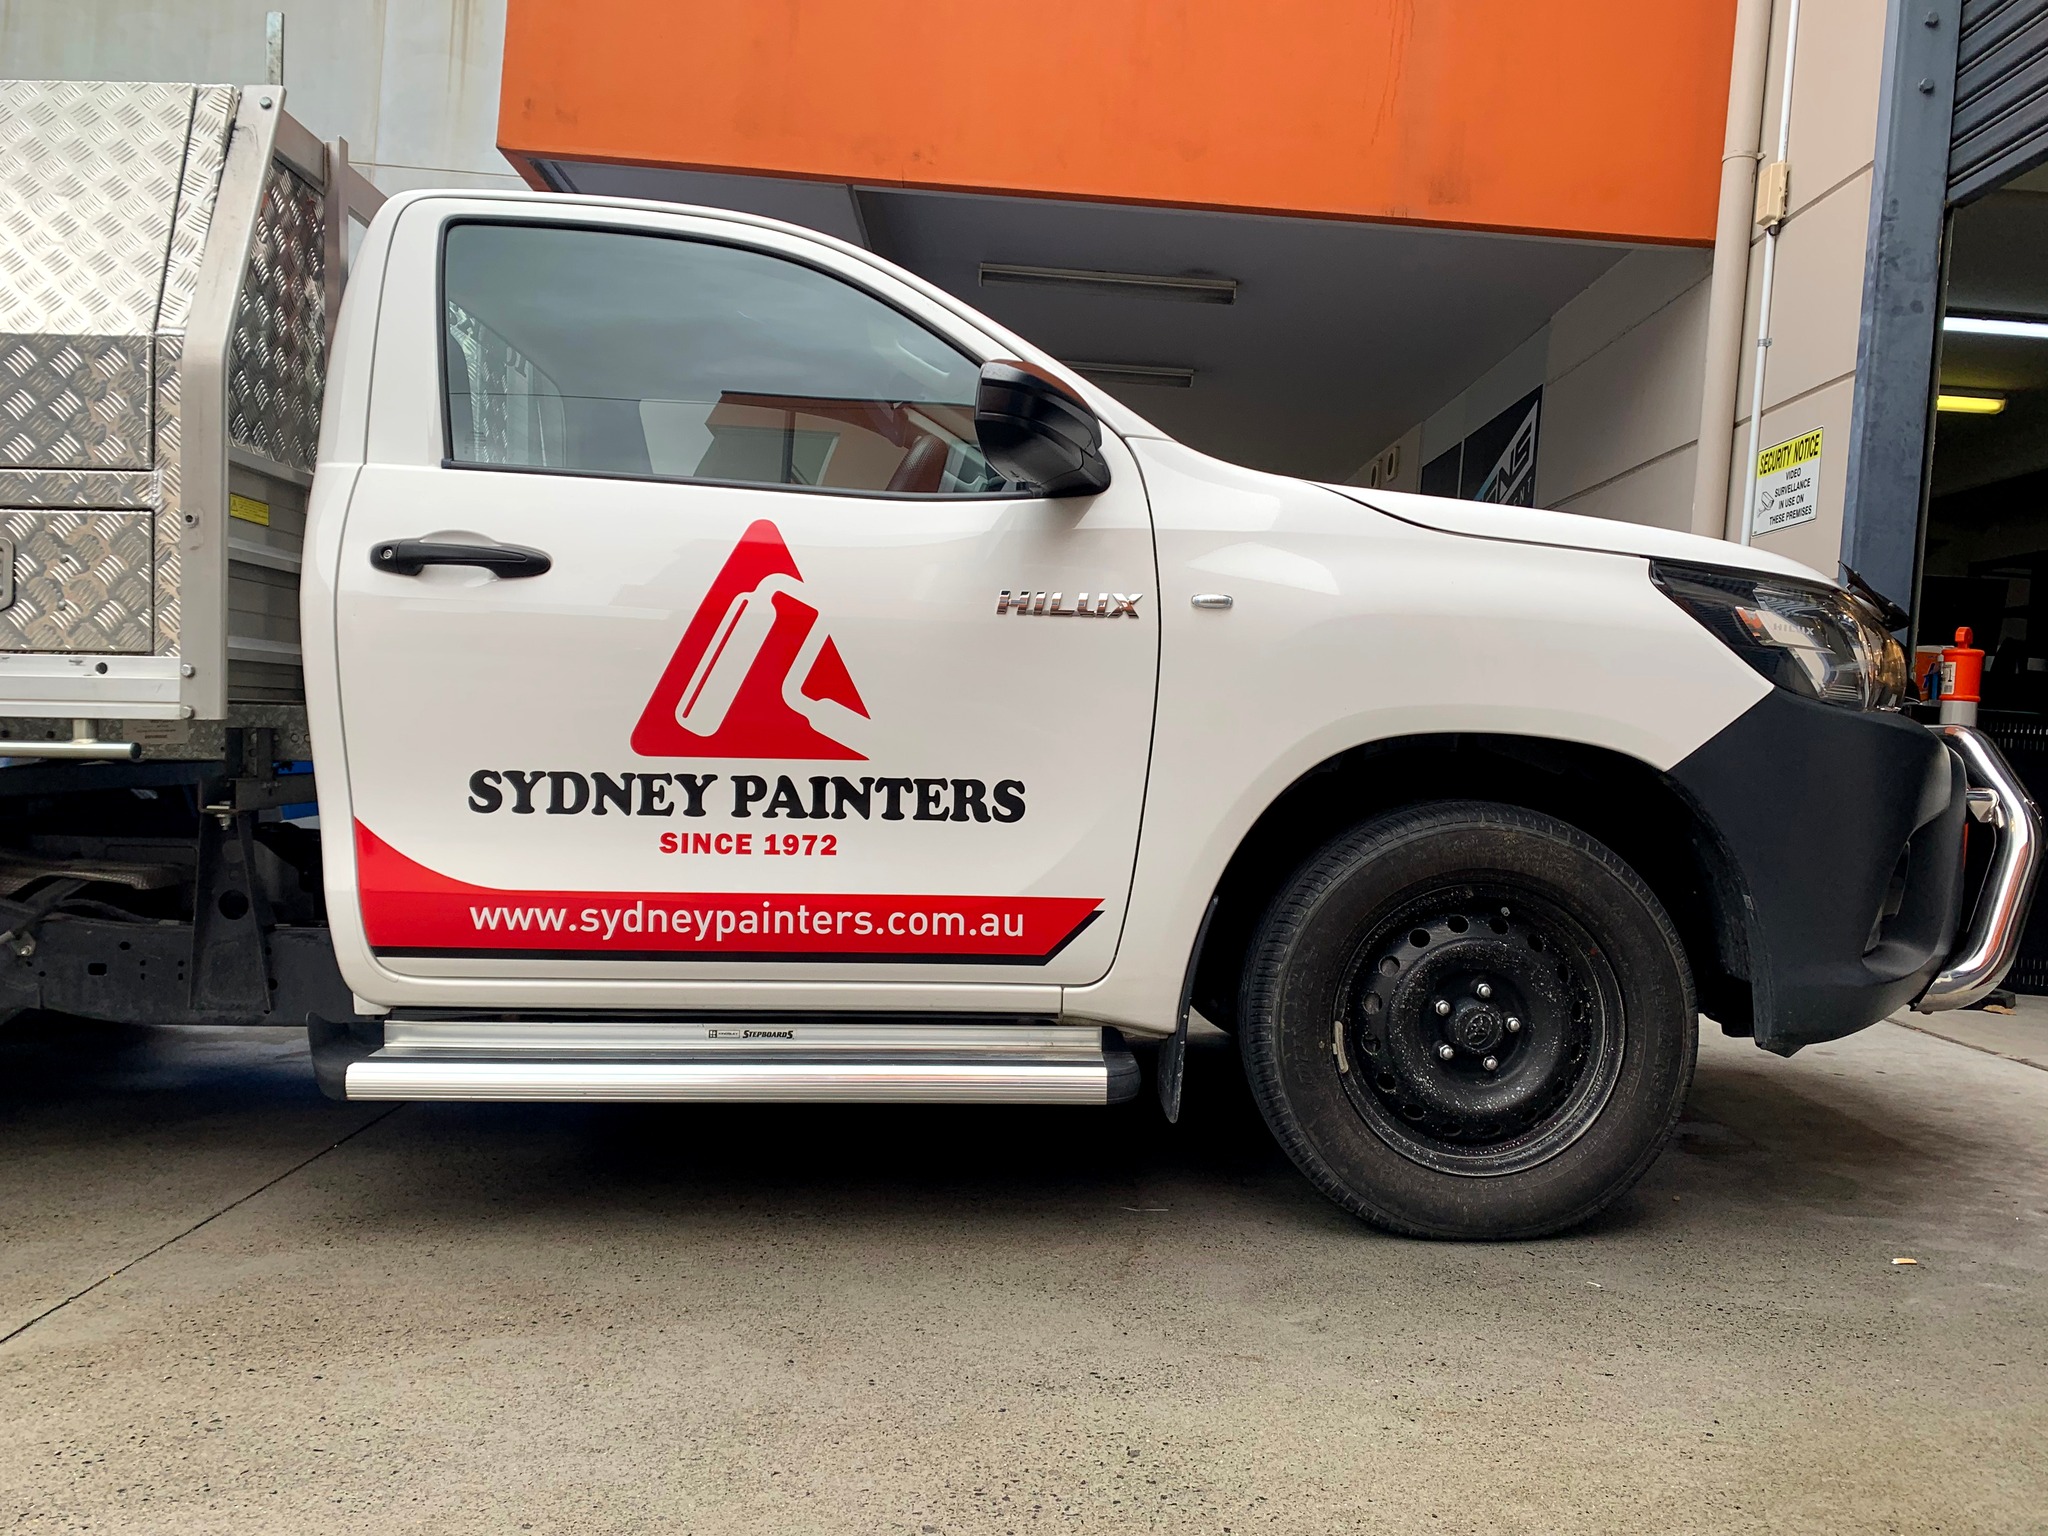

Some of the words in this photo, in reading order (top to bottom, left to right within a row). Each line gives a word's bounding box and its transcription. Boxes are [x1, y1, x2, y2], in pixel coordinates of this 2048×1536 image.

[1759, 444, 1792, 475] SECURITY
[1793, 433, 1820, 463] NOTICE
[1785, 467, 1802, 480] VIDEO
[1785, 496, 1796, 508] USE
[1796, 494, 1804, 504] ON
[1769, 514, 1785, 525] THESE
[1785, 505, 1812, 521] PREMISES
[997, 589, 1143, 619] HILUX
[468, 769, 719, 817] SYDNEY
[730, 775, 1026, 823] PAINTERS
[659, 832, 752, 855] SINCE
[764, 833, 837, 856] 1972
[469, 901, 1024, 941] www.sydneypainters.com.au
[742, 1030, 794, 1039] STEPBOARDS
